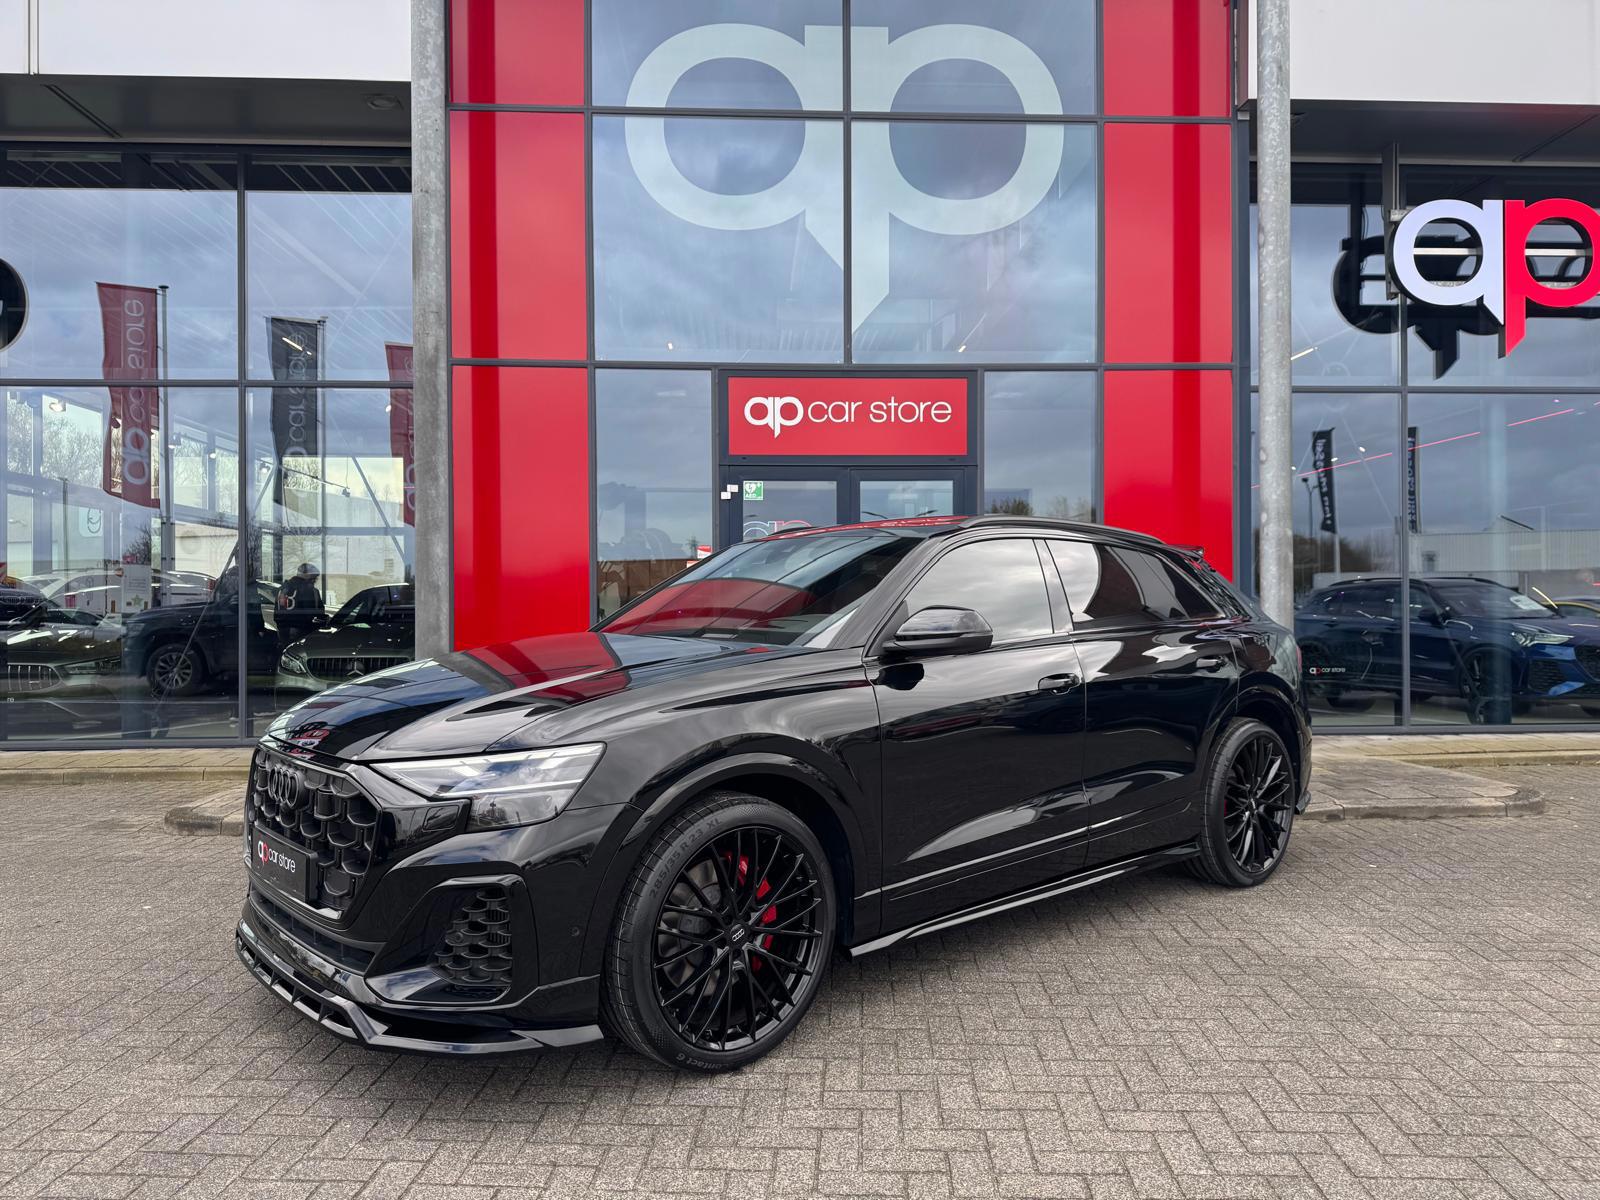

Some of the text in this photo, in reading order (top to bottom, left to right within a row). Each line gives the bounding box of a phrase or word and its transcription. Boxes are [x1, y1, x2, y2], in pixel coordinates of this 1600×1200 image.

[625, 23, 1064, 334] ap
[1393, 198, 1600, 357] ap
[744, 396, 952, 438] ap car store
[258, 840, 296, 873] ap car store
[649, 818, 721, 898] 285/35 R 23 XL
